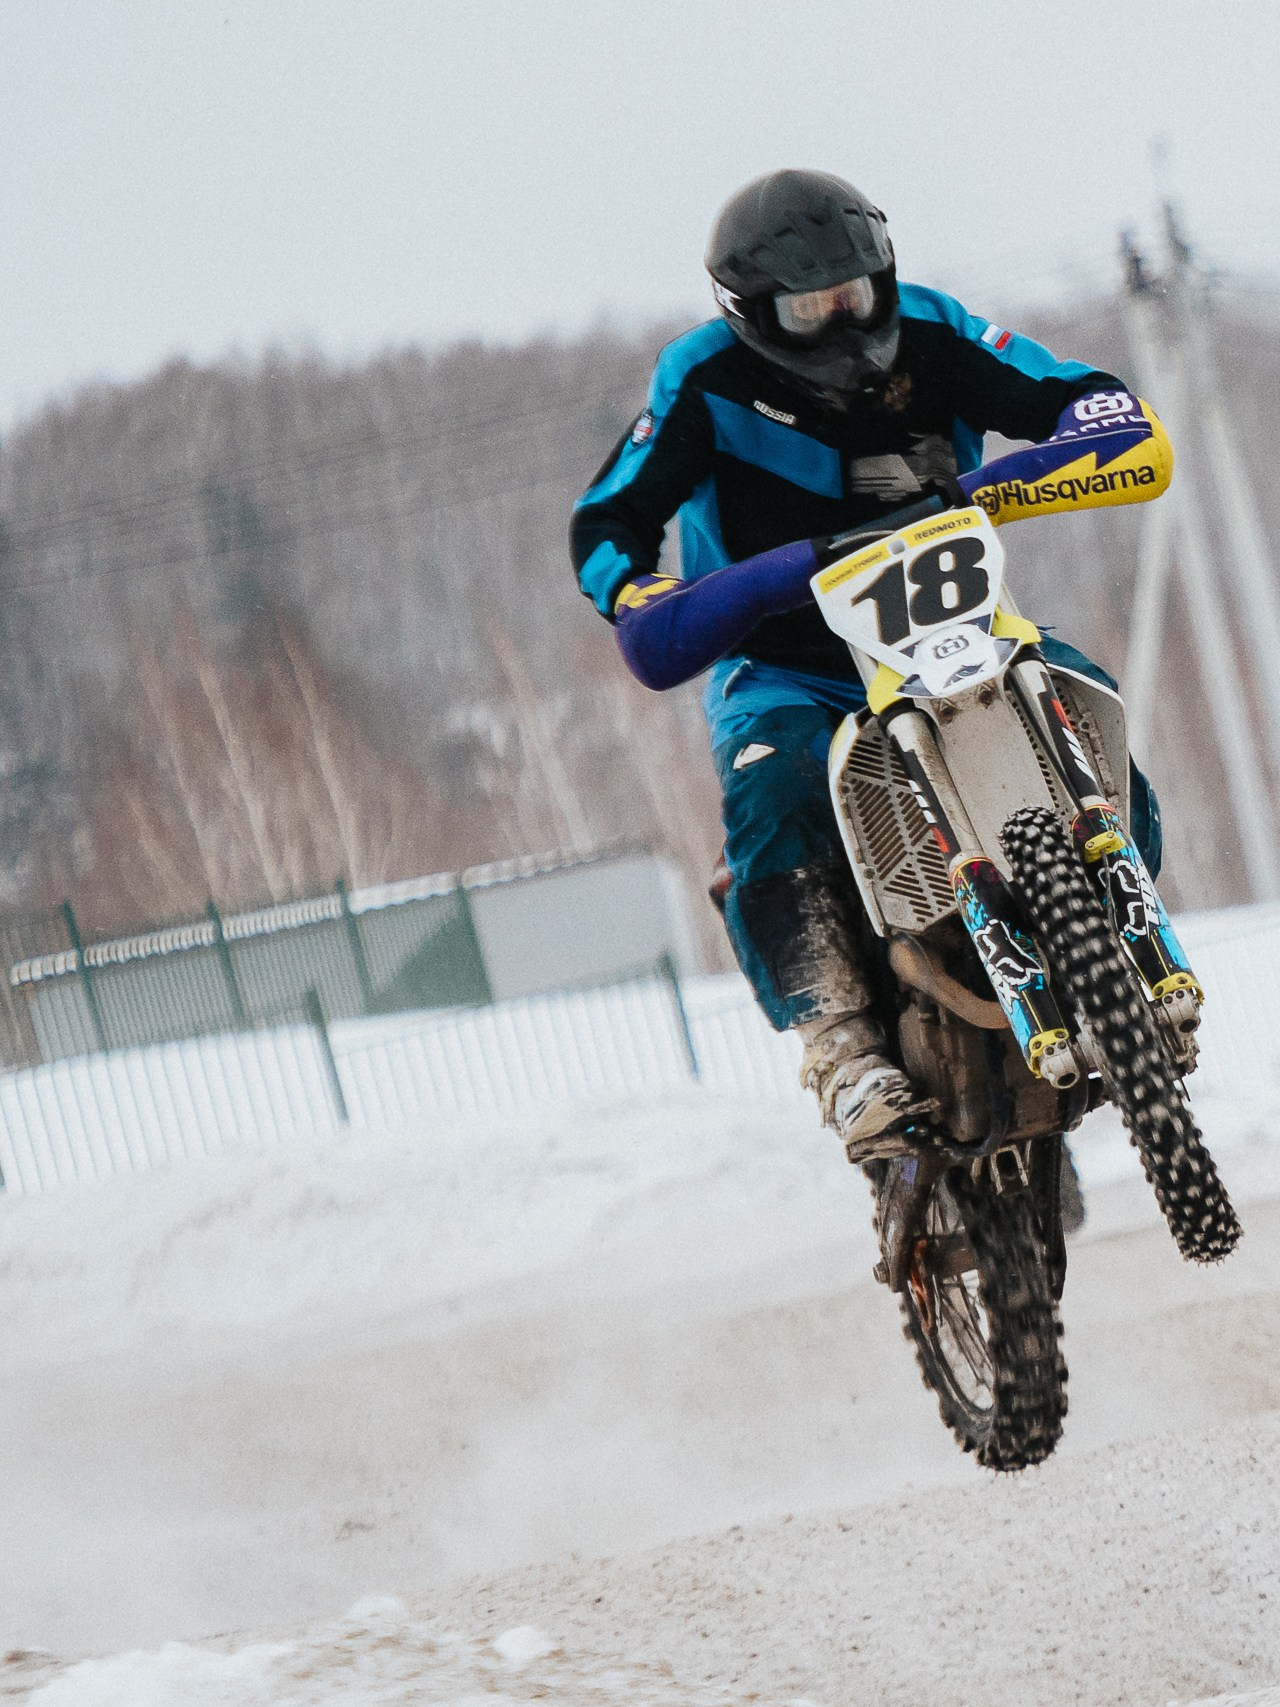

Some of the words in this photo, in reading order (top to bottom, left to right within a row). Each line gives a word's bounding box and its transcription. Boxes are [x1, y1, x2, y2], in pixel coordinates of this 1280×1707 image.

[753, 400, 797, 425] RUSSIA
[1000, 465, 1156, 507] Husqvarna
[913, 517, 972, 541] REDMOTO
[850, 536, 990, 647] 18
